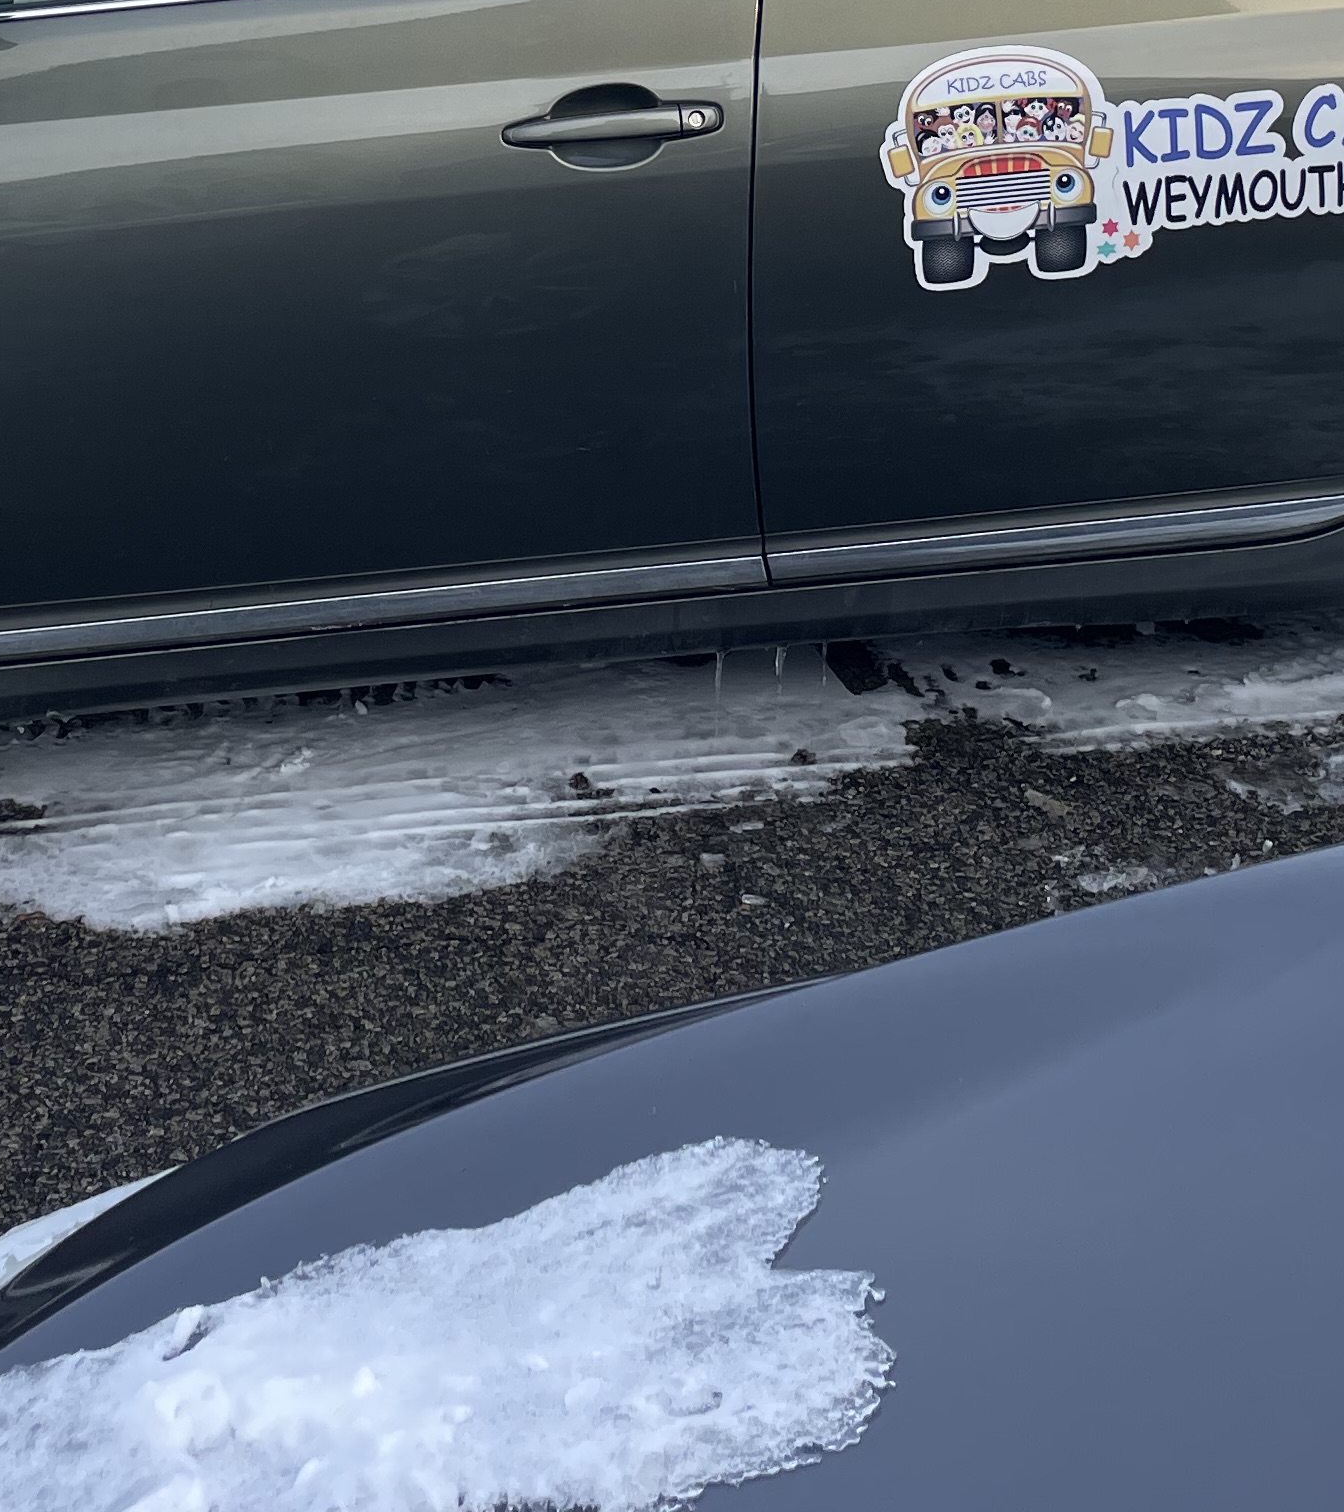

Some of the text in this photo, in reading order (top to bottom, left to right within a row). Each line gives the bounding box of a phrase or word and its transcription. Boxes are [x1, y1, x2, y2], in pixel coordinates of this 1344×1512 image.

[946, 70, 1047, 94] KIDZ CABS
[1123, 99, 1276, 168] KIDZ
